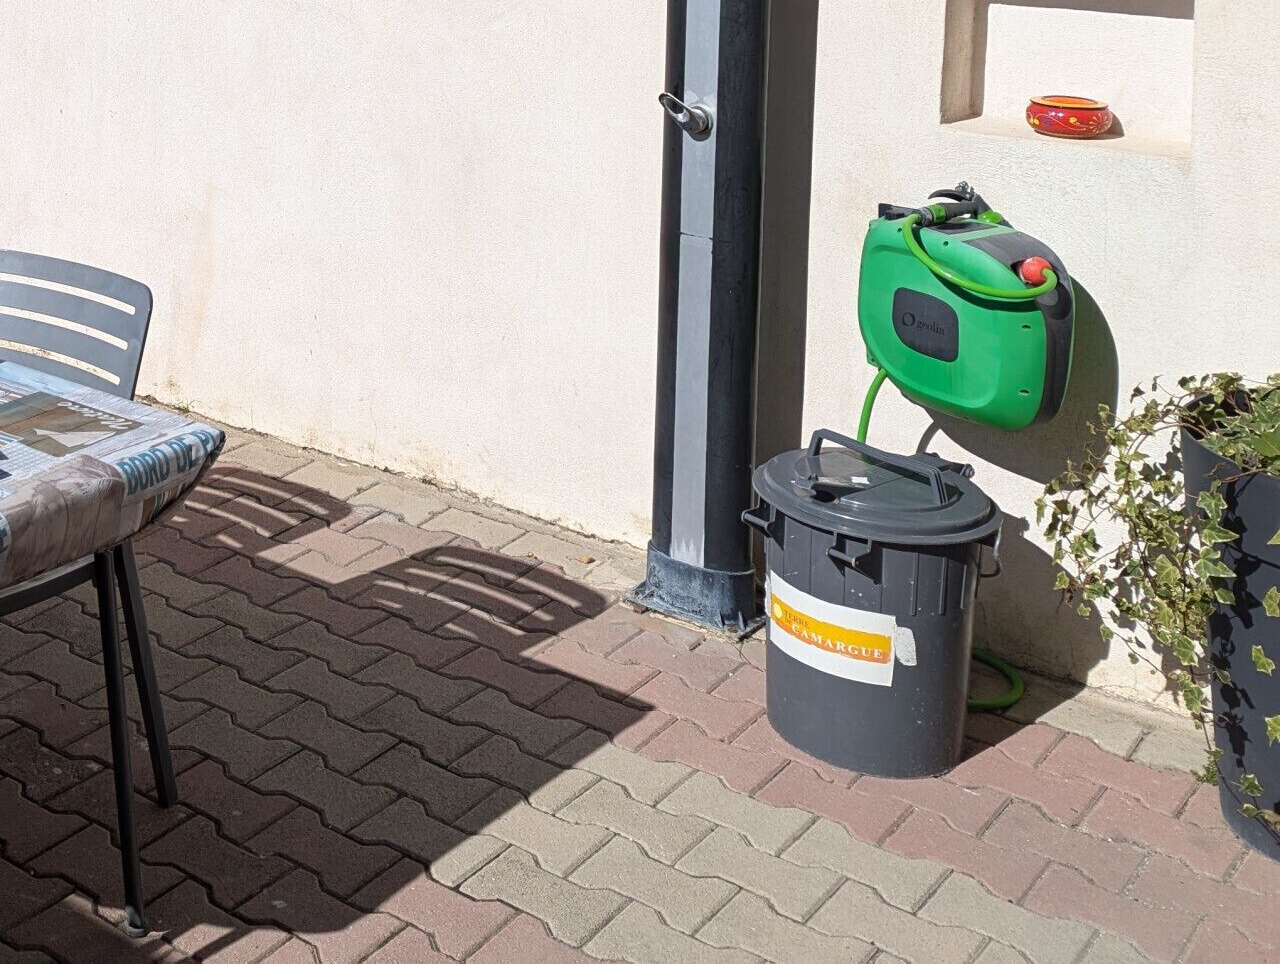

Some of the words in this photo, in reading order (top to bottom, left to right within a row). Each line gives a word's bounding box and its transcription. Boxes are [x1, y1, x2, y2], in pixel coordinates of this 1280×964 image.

[116, 448, 170, 496] BORD
[165, 437, 202, 476] DE
[784, 609, 811, 629] TERRE
[790, 622, 883, 660] CAMARGUE
